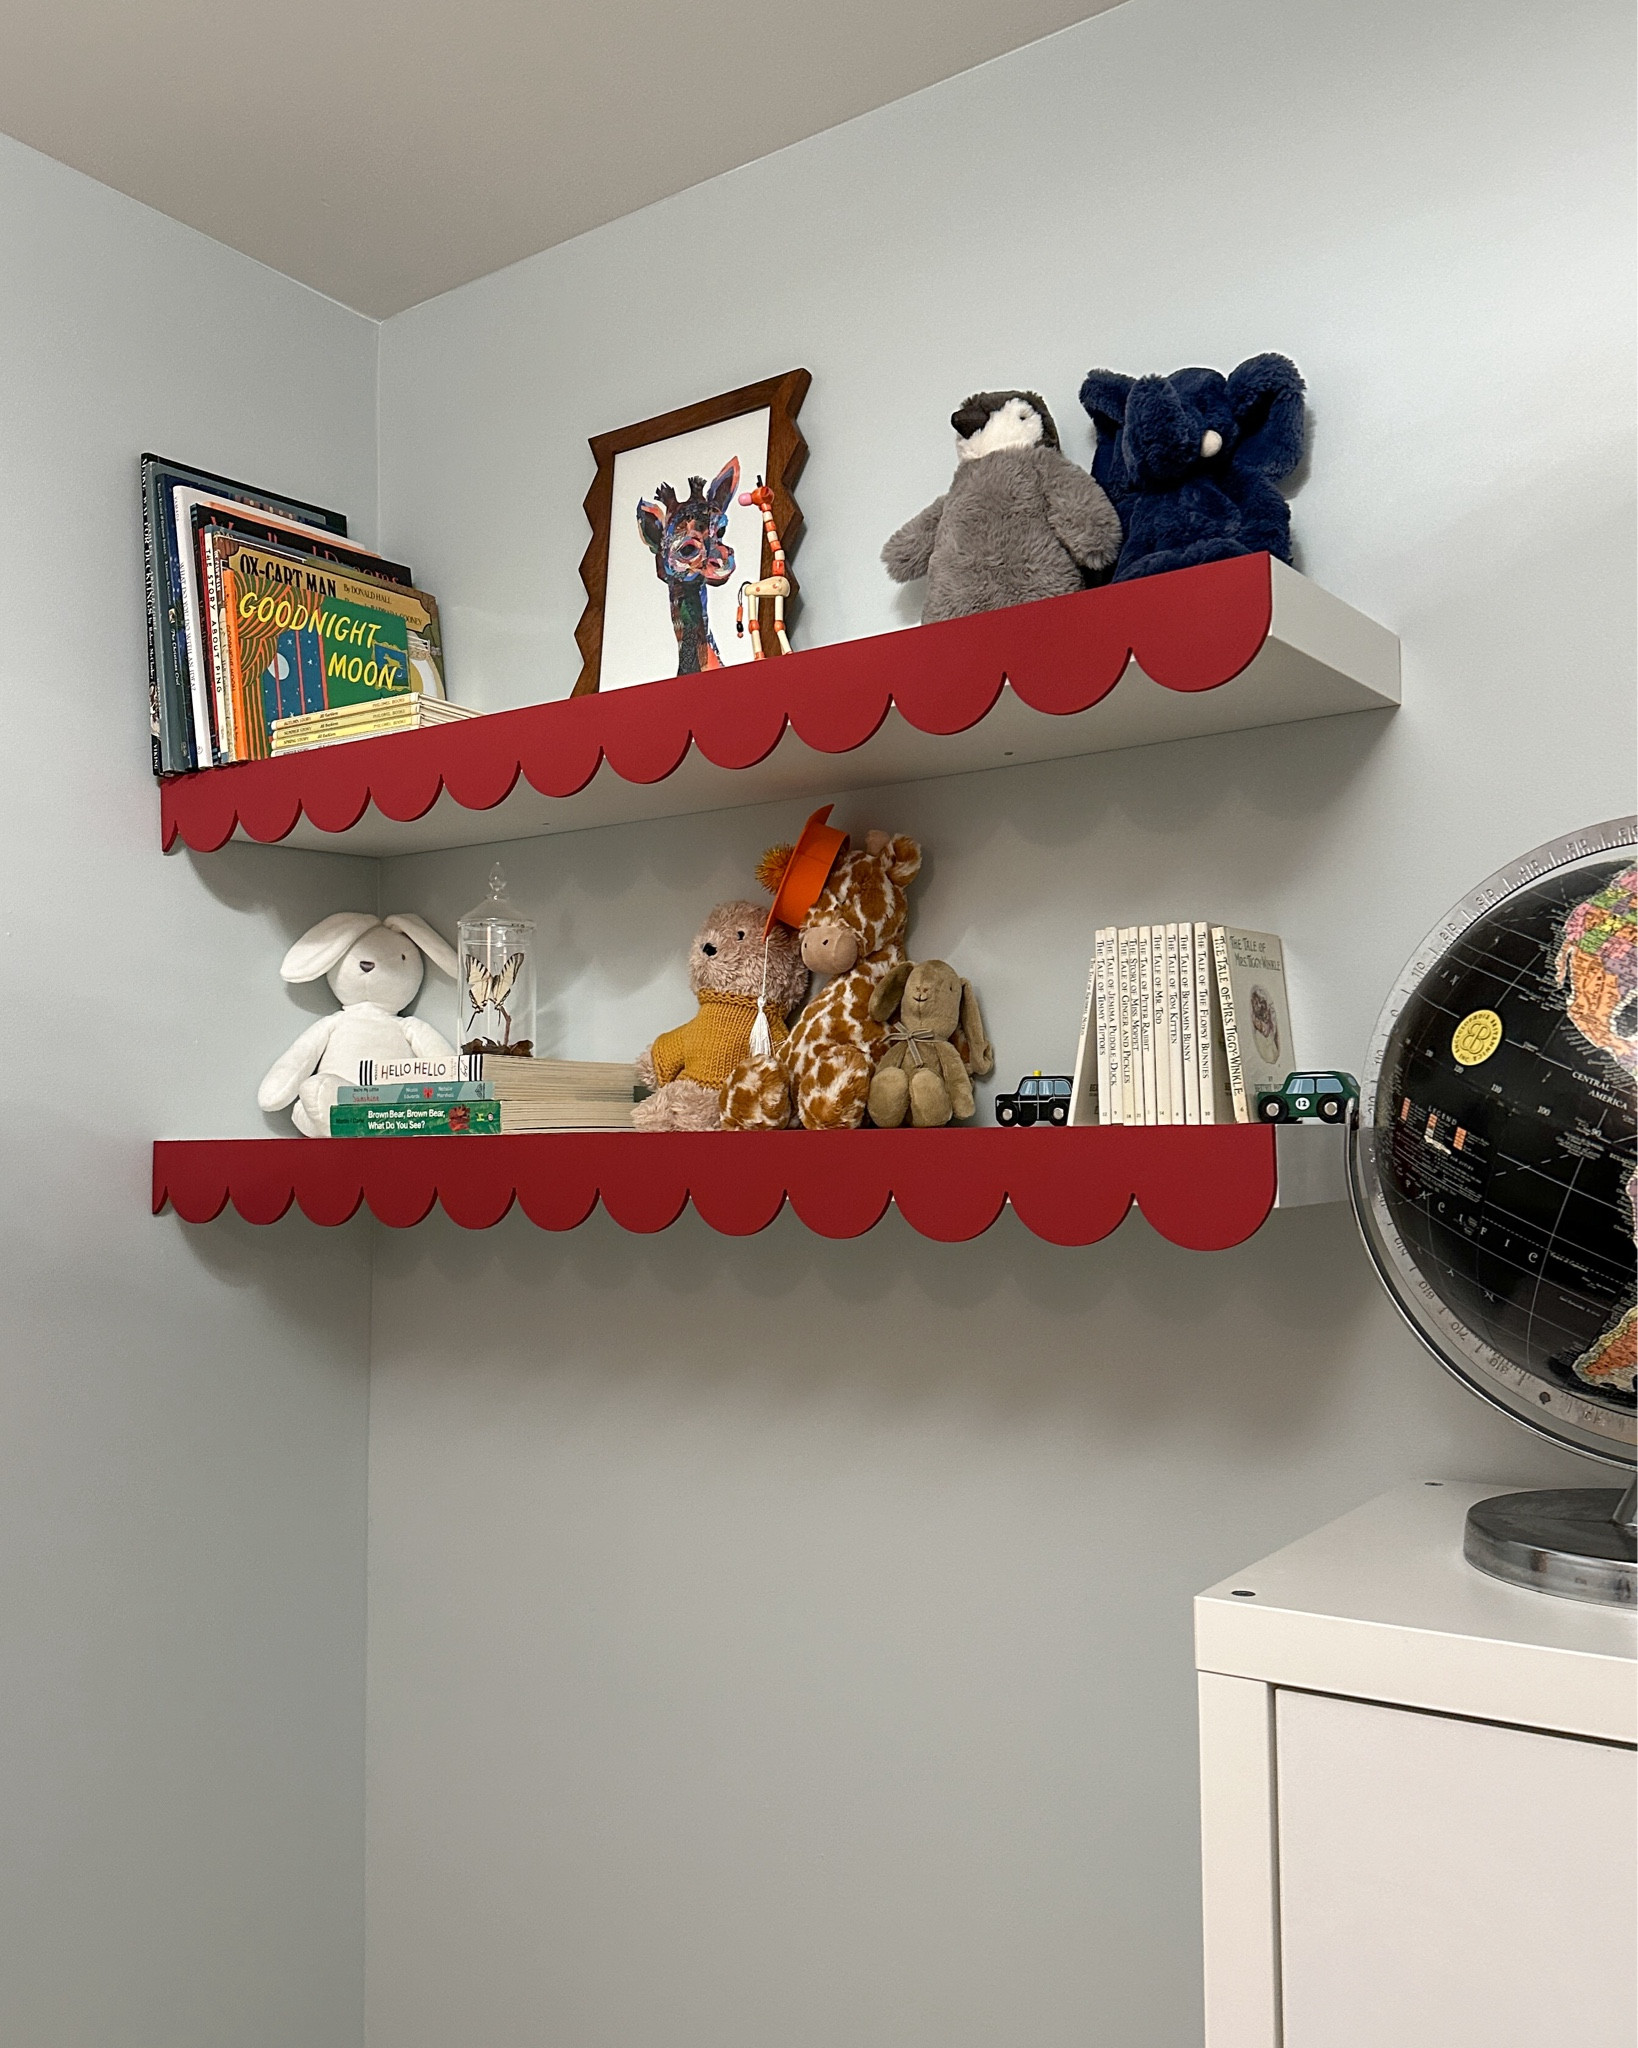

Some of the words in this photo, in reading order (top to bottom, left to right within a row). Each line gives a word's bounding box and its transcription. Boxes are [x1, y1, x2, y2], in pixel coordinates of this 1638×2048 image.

[240, 553, 303, 588] OX-CART
[305, 572, 337, 598] MAN
[207, 574, 216, 610] STORY
[351, 585, 376, 600] DONALD
[376, 593, 393, 605] HALL
[239, 591, 382, 649] GOODNIGHT
[211, 621, 220, 658] ABOUT
[215, 666, 223, 693] PING
[328, 652, 398, 690] MOON
[1106, 938, 1114, 952] THE
[1120, 940, 1128, 955] THE
[1129, 938, 1137, 954] THE
[1154, 935, 1162, 952] THE
[1167, 935, 1175, 951] THE
[1180, 935, 1188, 951] THE
[1197, 932, 1205, 948] THE
[1214, 936, 1226, 956] THE
[1229, 935, 1241, 950] THE
[1243, 937, 1257, 952] TALE
[1258, 942, 1266, 953] OF
[1097, 959, 1105, 978] TALE
[1107, 956, 1115, 976] TALE
[1121, 959, 1129, 978] TALE
[1130, 958, 1138, 982] STORY
[1140, 957, 1148, 977] TALE
[1154, 953, 1162, 973] TALE
[1168, 954, 1176, 974] TALE
[1181, 953, 1189, 973] TALE
[1198, 951, 1206, 972] TALE
[1218, 957, 1230, 983] TALE
[1098, 982, 1104, 991] OF
[1107, 979, 1114, 989] OF
[1121, 982, 1128, 991] OF
[1141, 980, 1148, 990] OF
[1155, 977, 1161, 987] OF
[1169, 978, 1176, 988] OF
[1182, 978, 1188, 989] OF
[1199, 974, 1205, 984] OF
[1131, 985, 1137, 995] OF
[1199, 989, 1207, 1006] THE
[1221, 986, 1230, 1001] OF
[1098, 994, 1106, 1020] TIMMY
[1108, 991, 1116, 1022] JEMIMA
[1122, 995, 1130, 1027] GINGER
[1131, 999, 1139, 1017] MISS
[1141, 994, 1149, 1019] PETER
[1156, 1007, 1164, 1025] TOD
[1182, 990, 1191, 1031] BENJAMIN
[1170, 1012, 1178, 1044] KITTEN
[1200, 1009, 1208, 1040] FLOPSY
[1099, 1023, 1107, 1055] TIPTOES
[1132, 1020, 1140, 1051] MOPPET
[1142, 1022, 1150, 1051] RABBIT
[1183, 1033, 1191, 1062] BUNNY
[381, 1063, 411, 1080] HELLO
[414, 1061, 446, 1076] HELLO
[1123, 1050, 1132, 1084] PICKLES
[1201, 1042, 1210, 1079] BUNNIES
[1225, 1025, 1244, 1097] TIGGY-WINKLE
[1571, 1069, 1611, 1092] CENTRAL
[1588, 1089, 1628, 1111] AMERICA
[367, 1110, 388, 1119] Brown
[389, 1109, 406, 1119] Bear,
[406, 1109, 428, 1118] Brown
[428, 1109, 446, 1118] Bear,
[1427, 1105, 1458, 1126] LEGEND
[1537, 1105, 1551, 1117] 100
[367, 1121, 385, 1130] What
[385, 1121, 395, 1130] Do
[396, 1121, 409, 1129] You
[409, 1120, 426, 1129] See?
